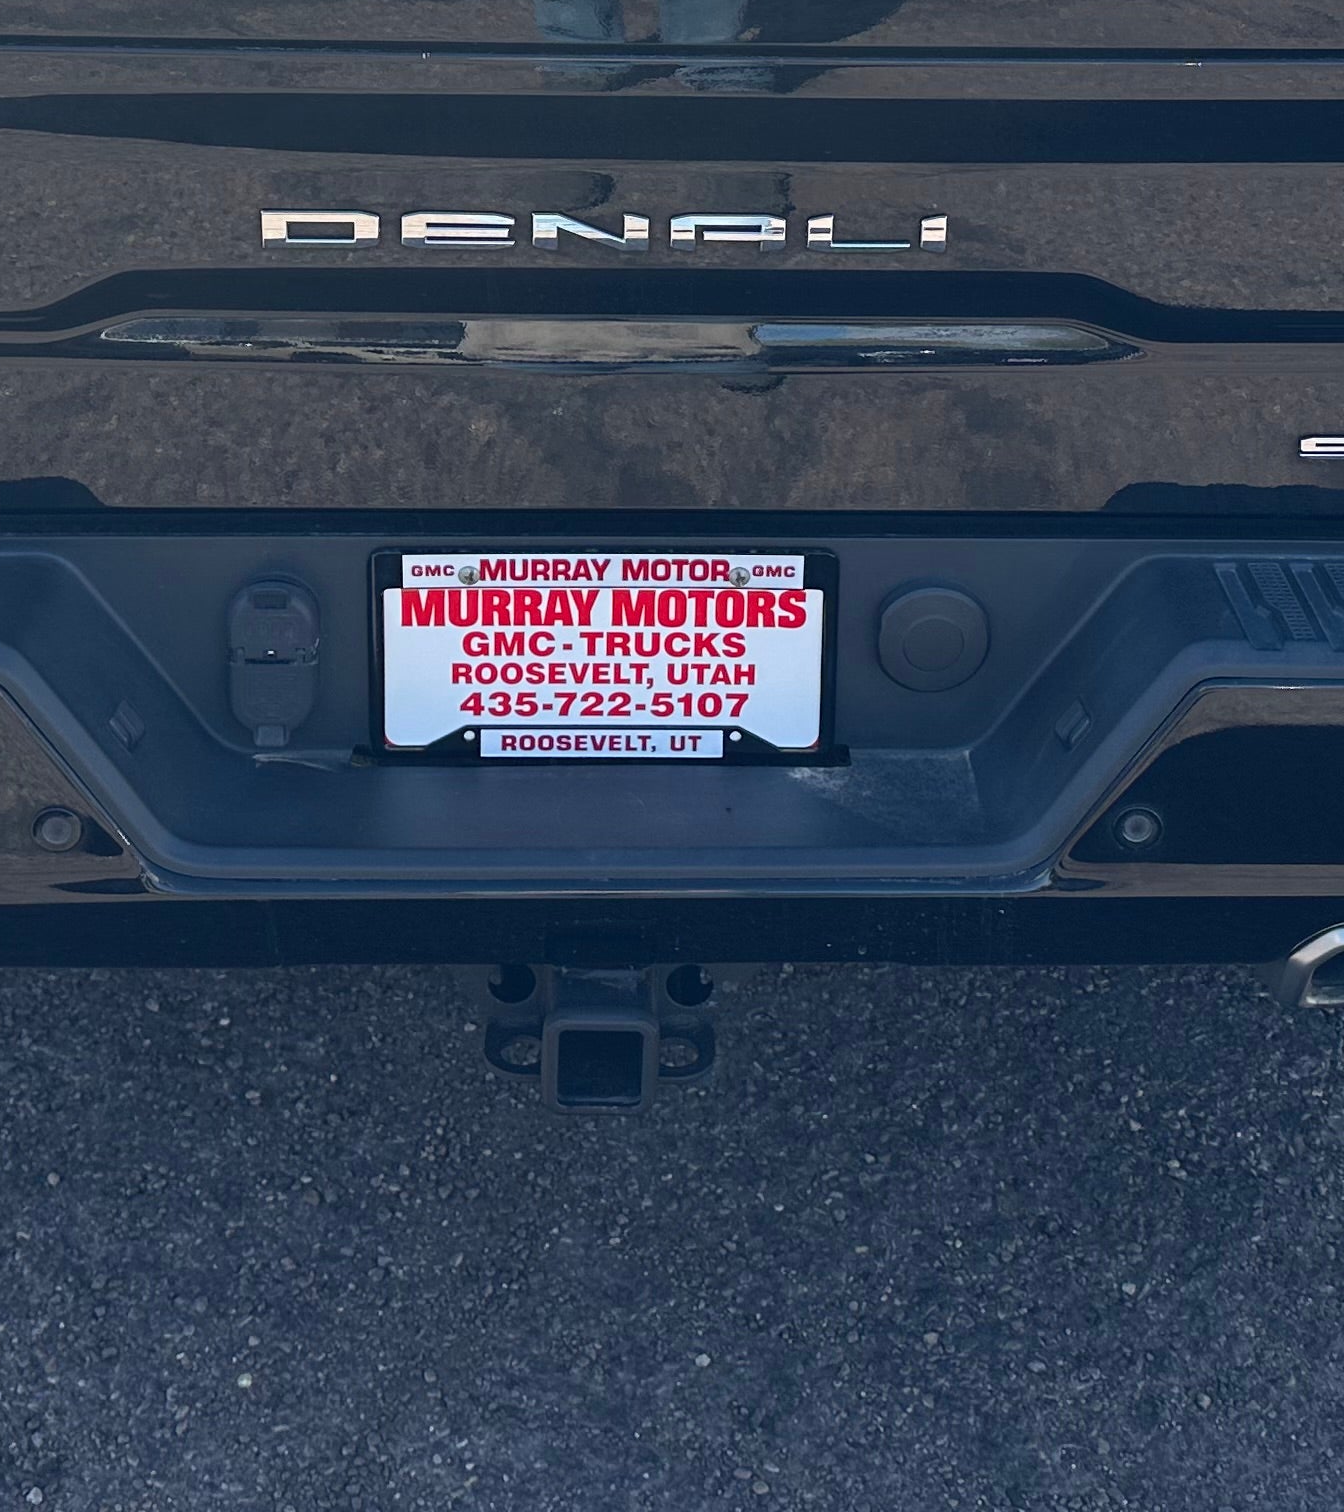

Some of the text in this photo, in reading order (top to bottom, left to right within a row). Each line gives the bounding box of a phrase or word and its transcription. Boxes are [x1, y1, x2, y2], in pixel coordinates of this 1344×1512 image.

[260, 209, 949, 253] DENALI
[411, 559, 796, 581] GMC MURRAY MOTOR GMC
[401, 589, 807, 628] MURRAY MOTORS
[452, 662, 757, 689] ROOSEVELT, UTAH
[460, 692, 749, 718] 435-722-5107
[500, 734, 703, 754] ROOSEVELT, UT
